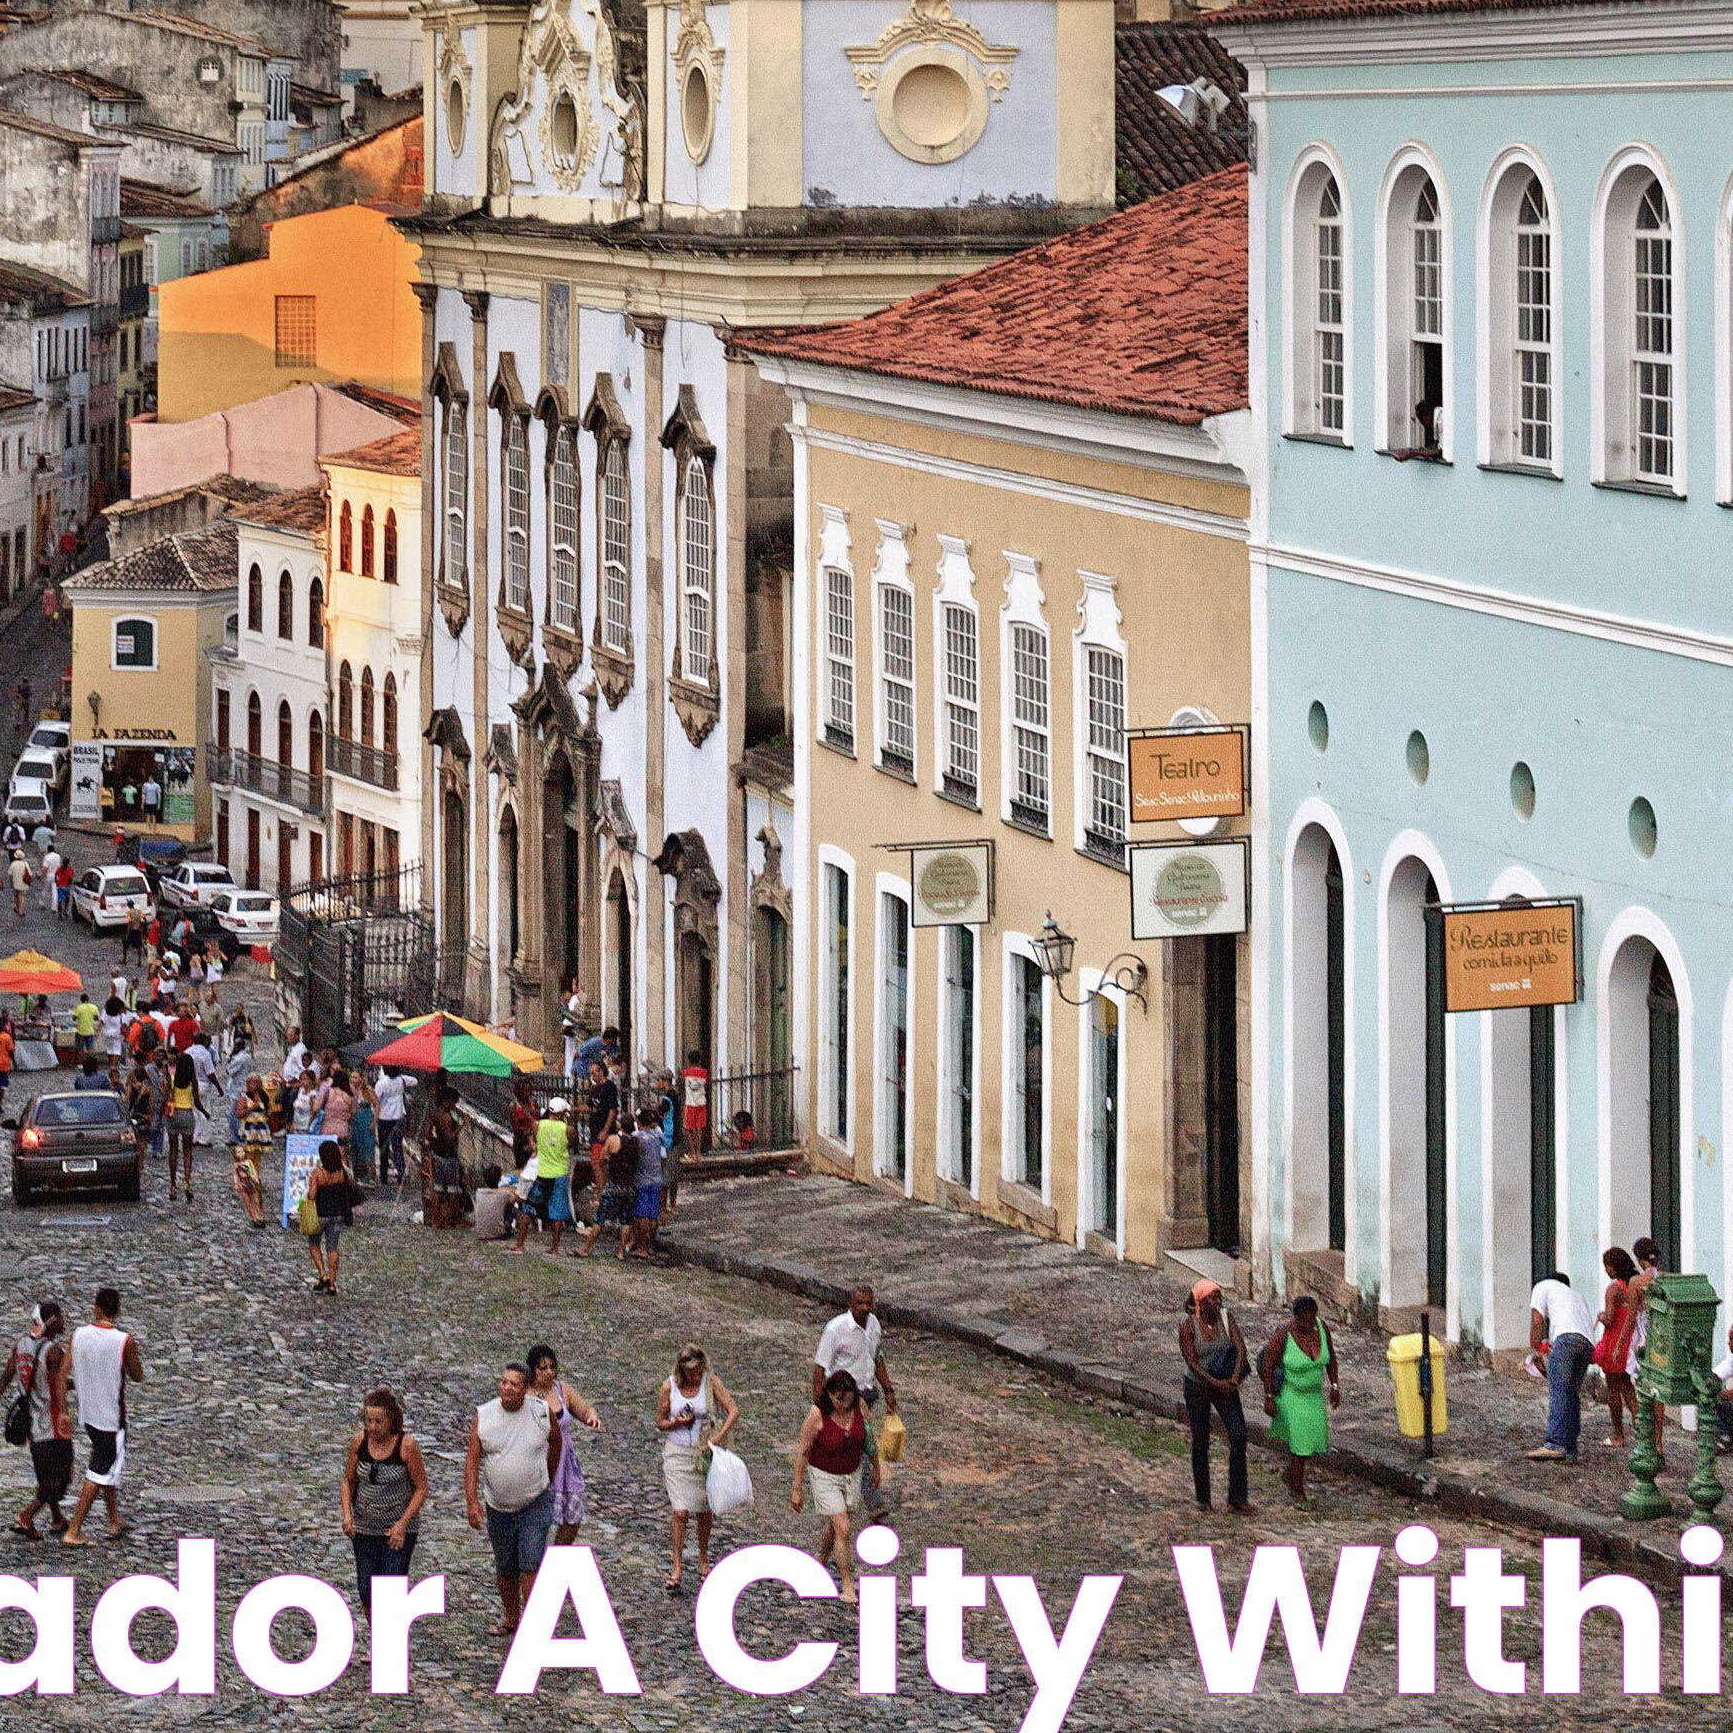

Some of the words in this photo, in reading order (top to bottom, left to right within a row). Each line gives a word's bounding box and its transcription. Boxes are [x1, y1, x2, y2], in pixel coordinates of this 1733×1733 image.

[113, 729, 177, 741] FAZENDA
[1150, 753, 1221, 780] Teatro
[1450, 925, 1568, 952] Restaurante
[1463, 950, 1513, 970] comida
[1522, 947, 1558, 974] quilo
[1490, 980, 1522, 992] senac
